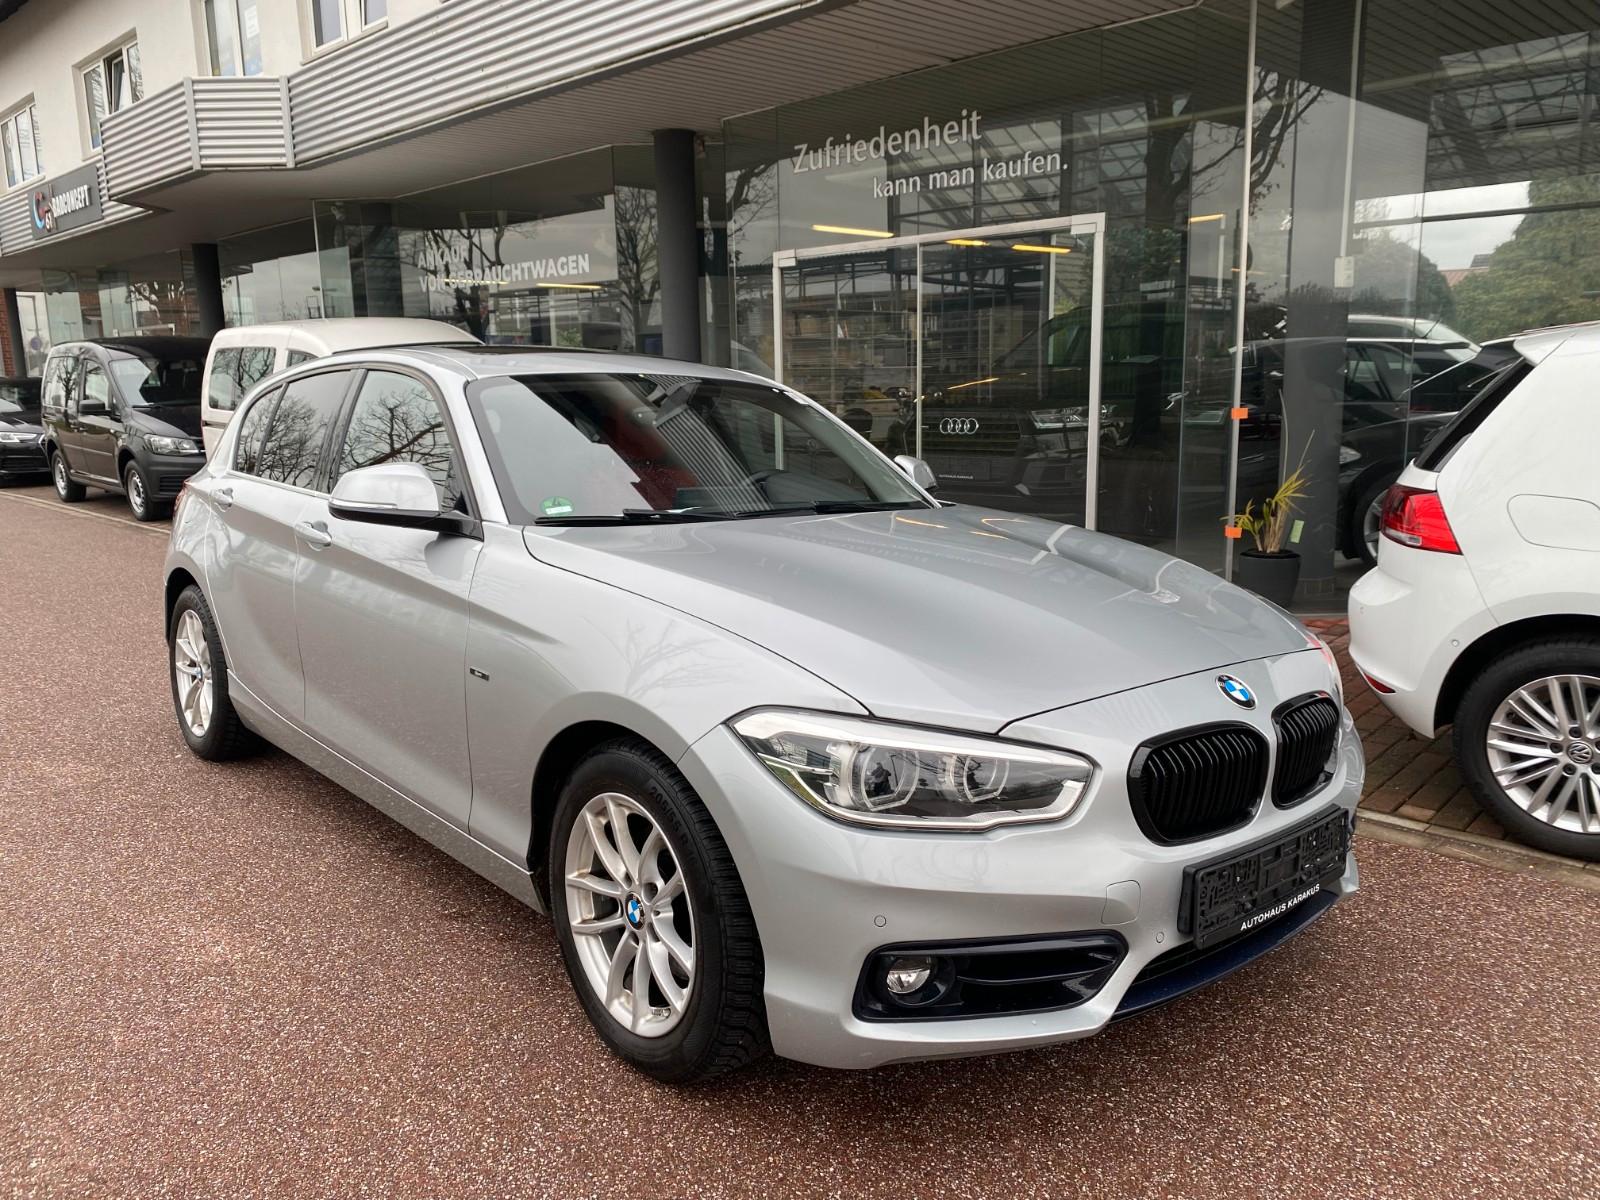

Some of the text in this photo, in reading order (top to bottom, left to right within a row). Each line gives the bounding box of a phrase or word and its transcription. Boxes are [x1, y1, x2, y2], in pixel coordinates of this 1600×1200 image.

[792, 108, 983, 175] Zufriedenheit
[873, 150, 1069, 199] kann man kaufen.
[417, 245, 468, 270] ANKAUF
[418, 253, 590, 293] VON GEBRAUCHTWAGEN
[1240, 883, 1320, 931] AUTOHAUS KARAKUS
